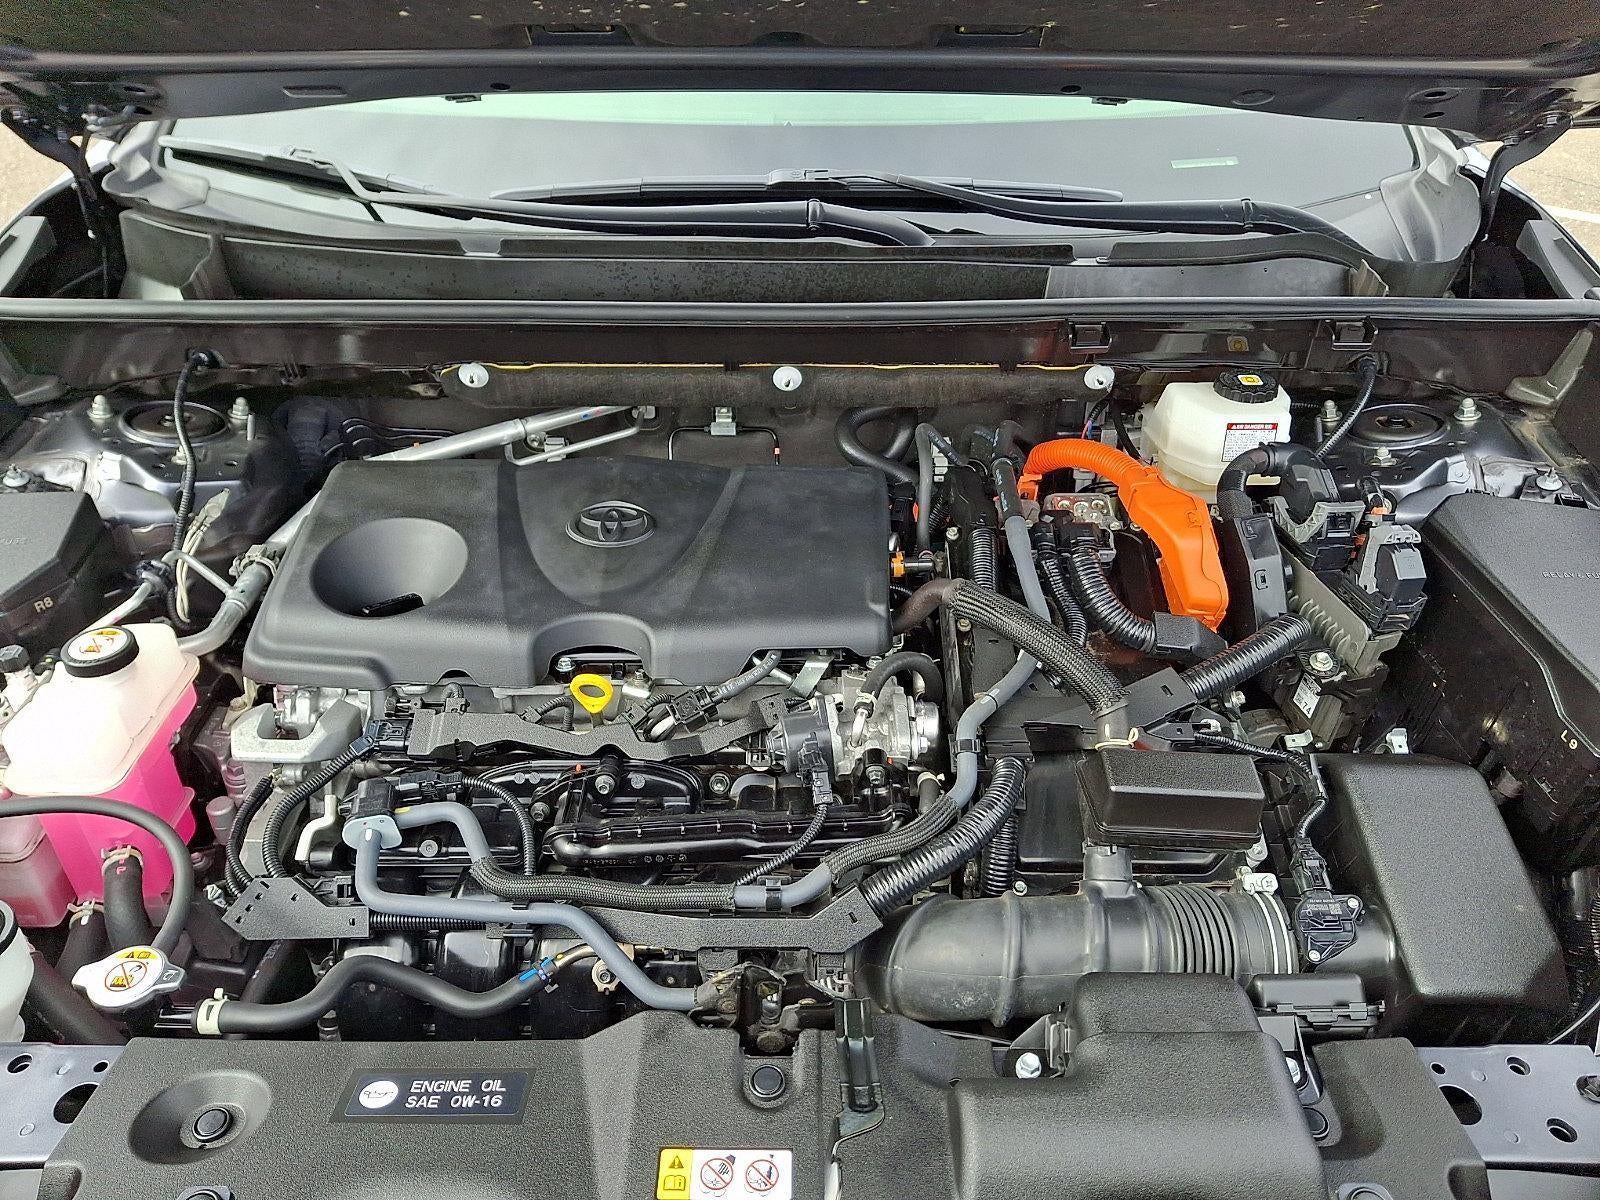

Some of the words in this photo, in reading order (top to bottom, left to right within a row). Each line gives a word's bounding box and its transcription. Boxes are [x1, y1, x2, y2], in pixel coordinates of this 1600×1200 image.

[34, 596, 54, 613] R8
[410, 1079, 471, 1093] ENGINE
[481, 1079, 506, 1093] OIL
[404, 1095, 441, 1108] SAE
[450, 1095, 503, 1108] 0W-16
